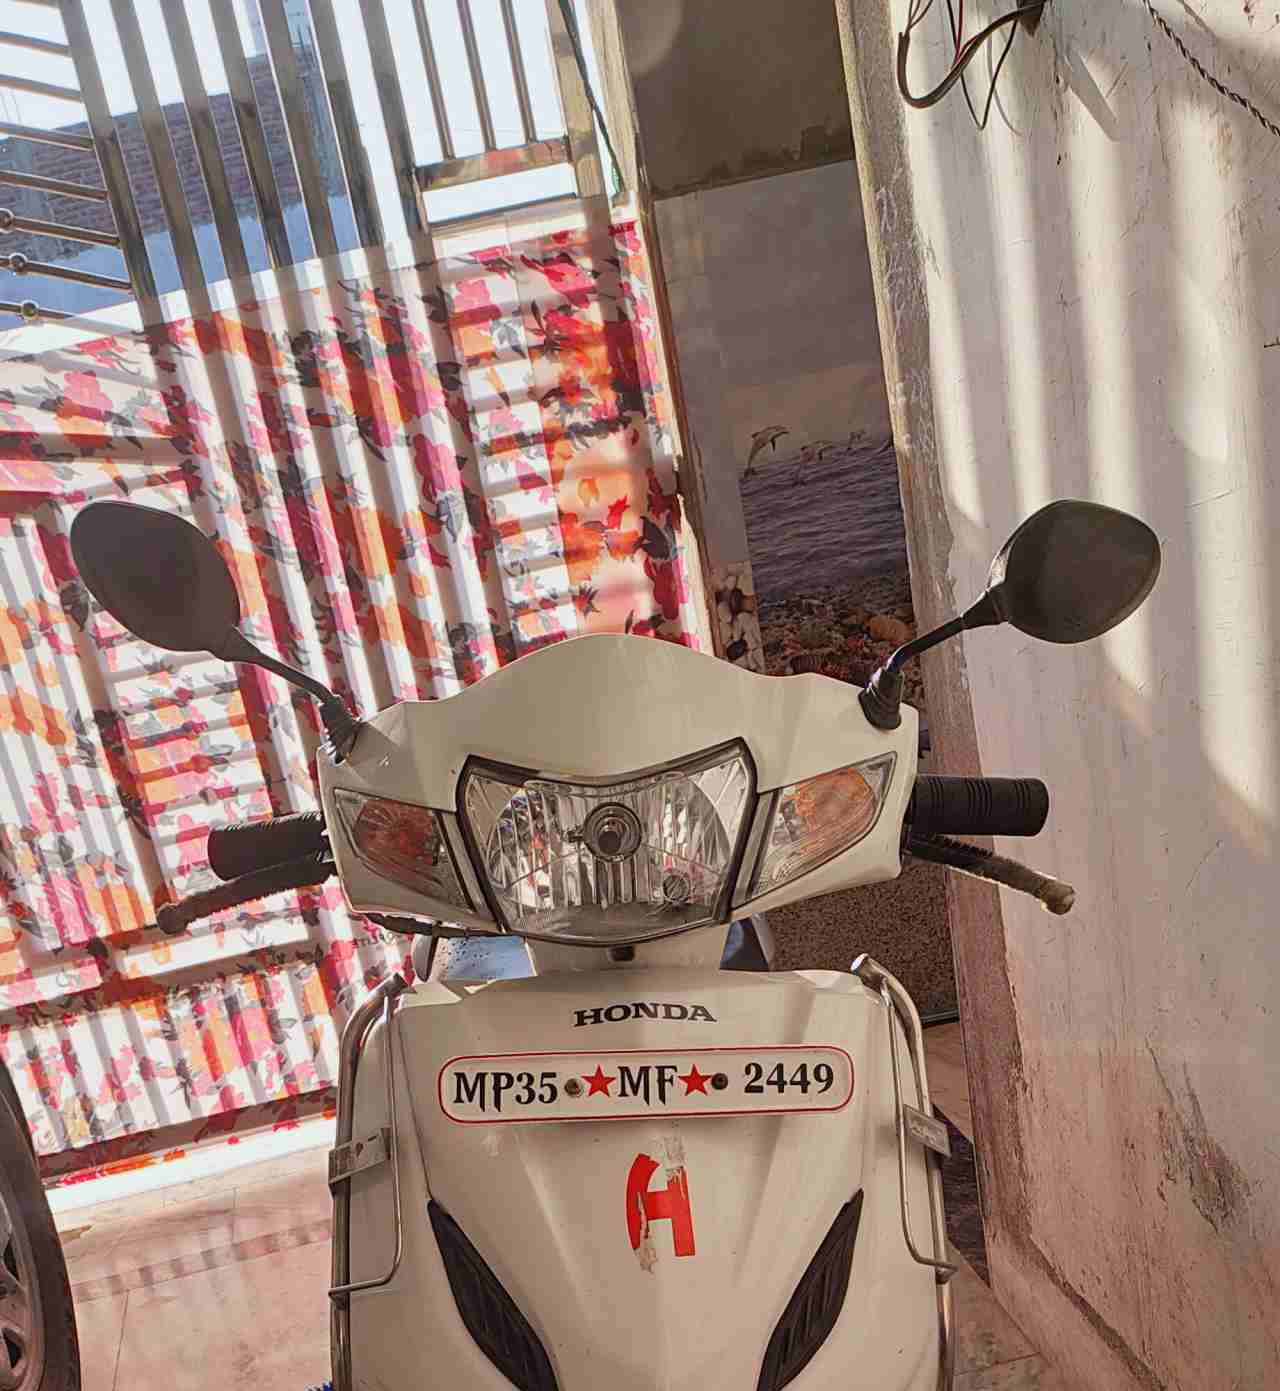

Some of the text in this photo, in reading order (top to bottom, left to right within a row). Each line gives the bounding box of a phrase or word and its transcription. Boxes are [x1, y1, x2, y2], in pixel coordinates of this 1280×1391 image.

[573, 1001, 718, 1028] HONDA
[452, 1062, 835, 1112] MP35 MF 2449
